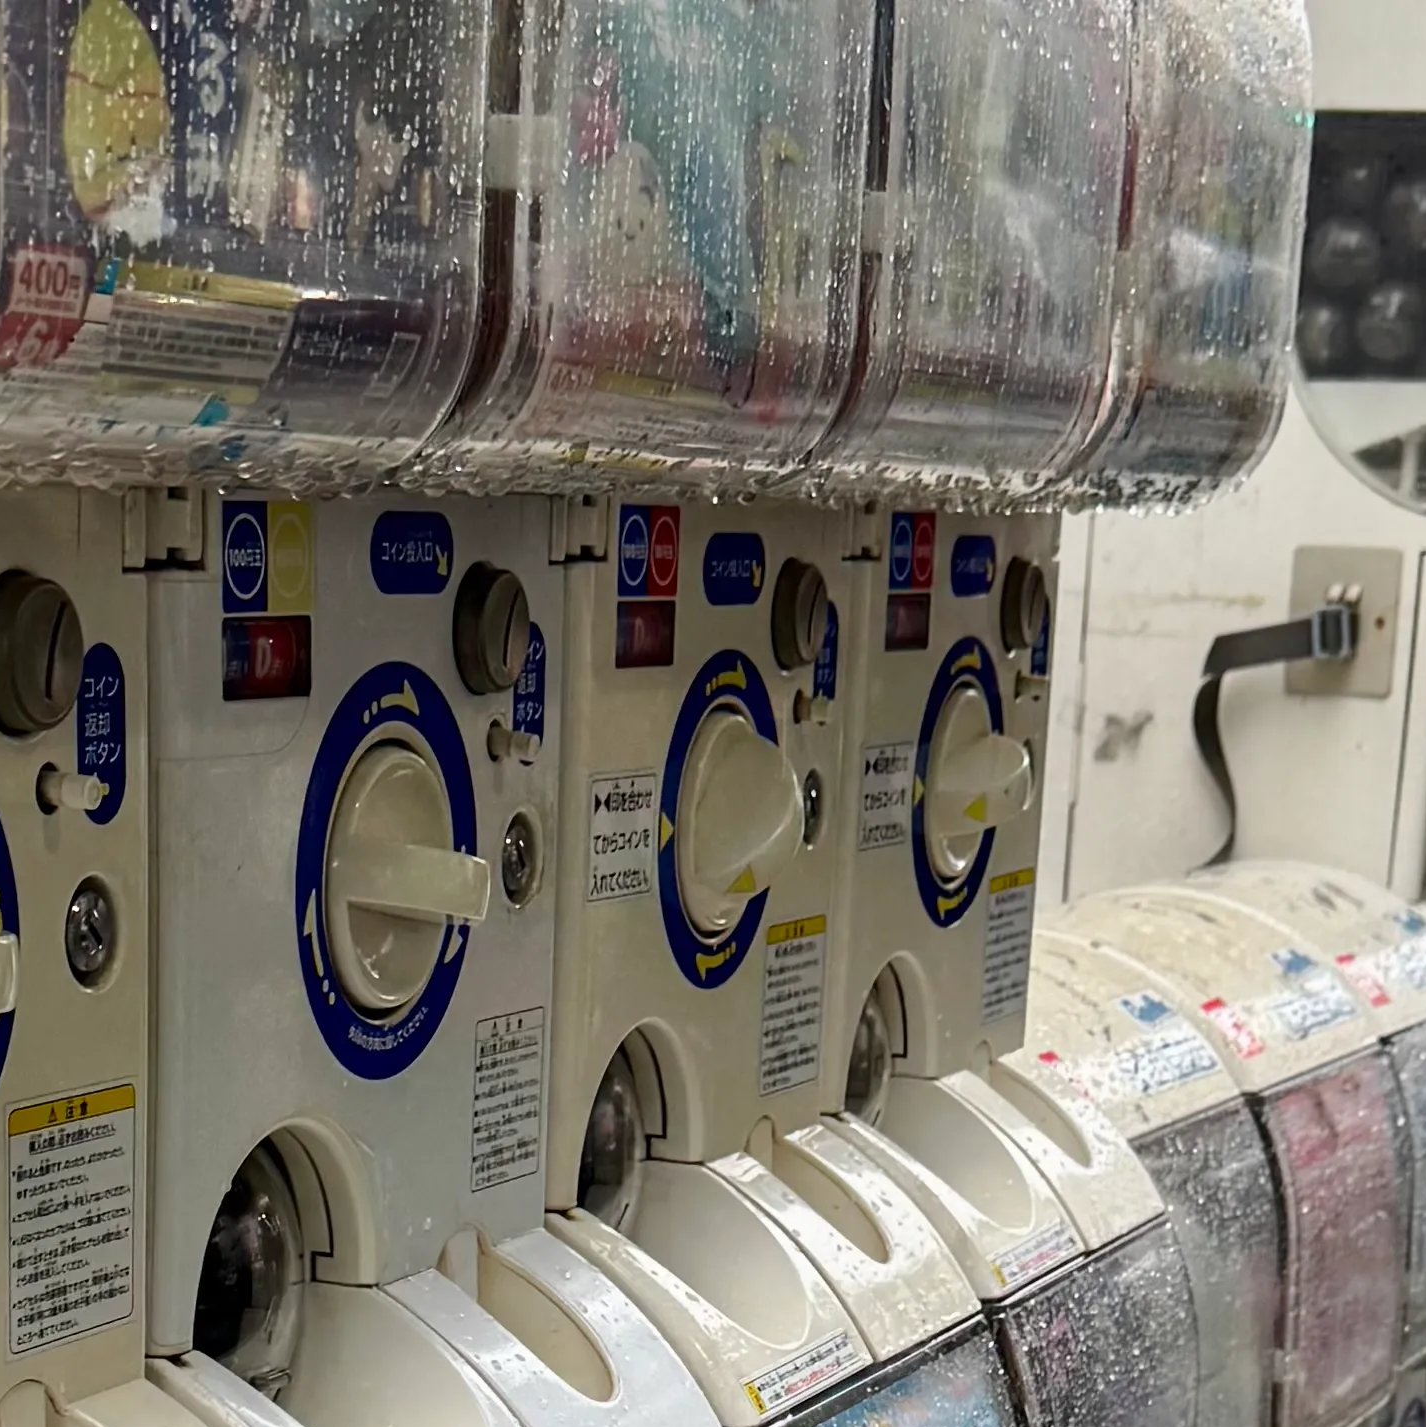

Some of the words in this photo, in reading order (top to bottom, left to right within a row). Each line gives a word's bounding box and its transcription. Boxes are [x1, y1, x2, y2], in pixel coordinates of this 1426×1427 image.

[381, 541, 433, 563] コイン投入口
[84, 676, 120, 698] コイン
[517, 703, 544, 722] ボタン
[84, 712, 111, 737] 返却
[84, 741, 121, 765] ボタン
[593, 829, 651, 855] てからコインを
